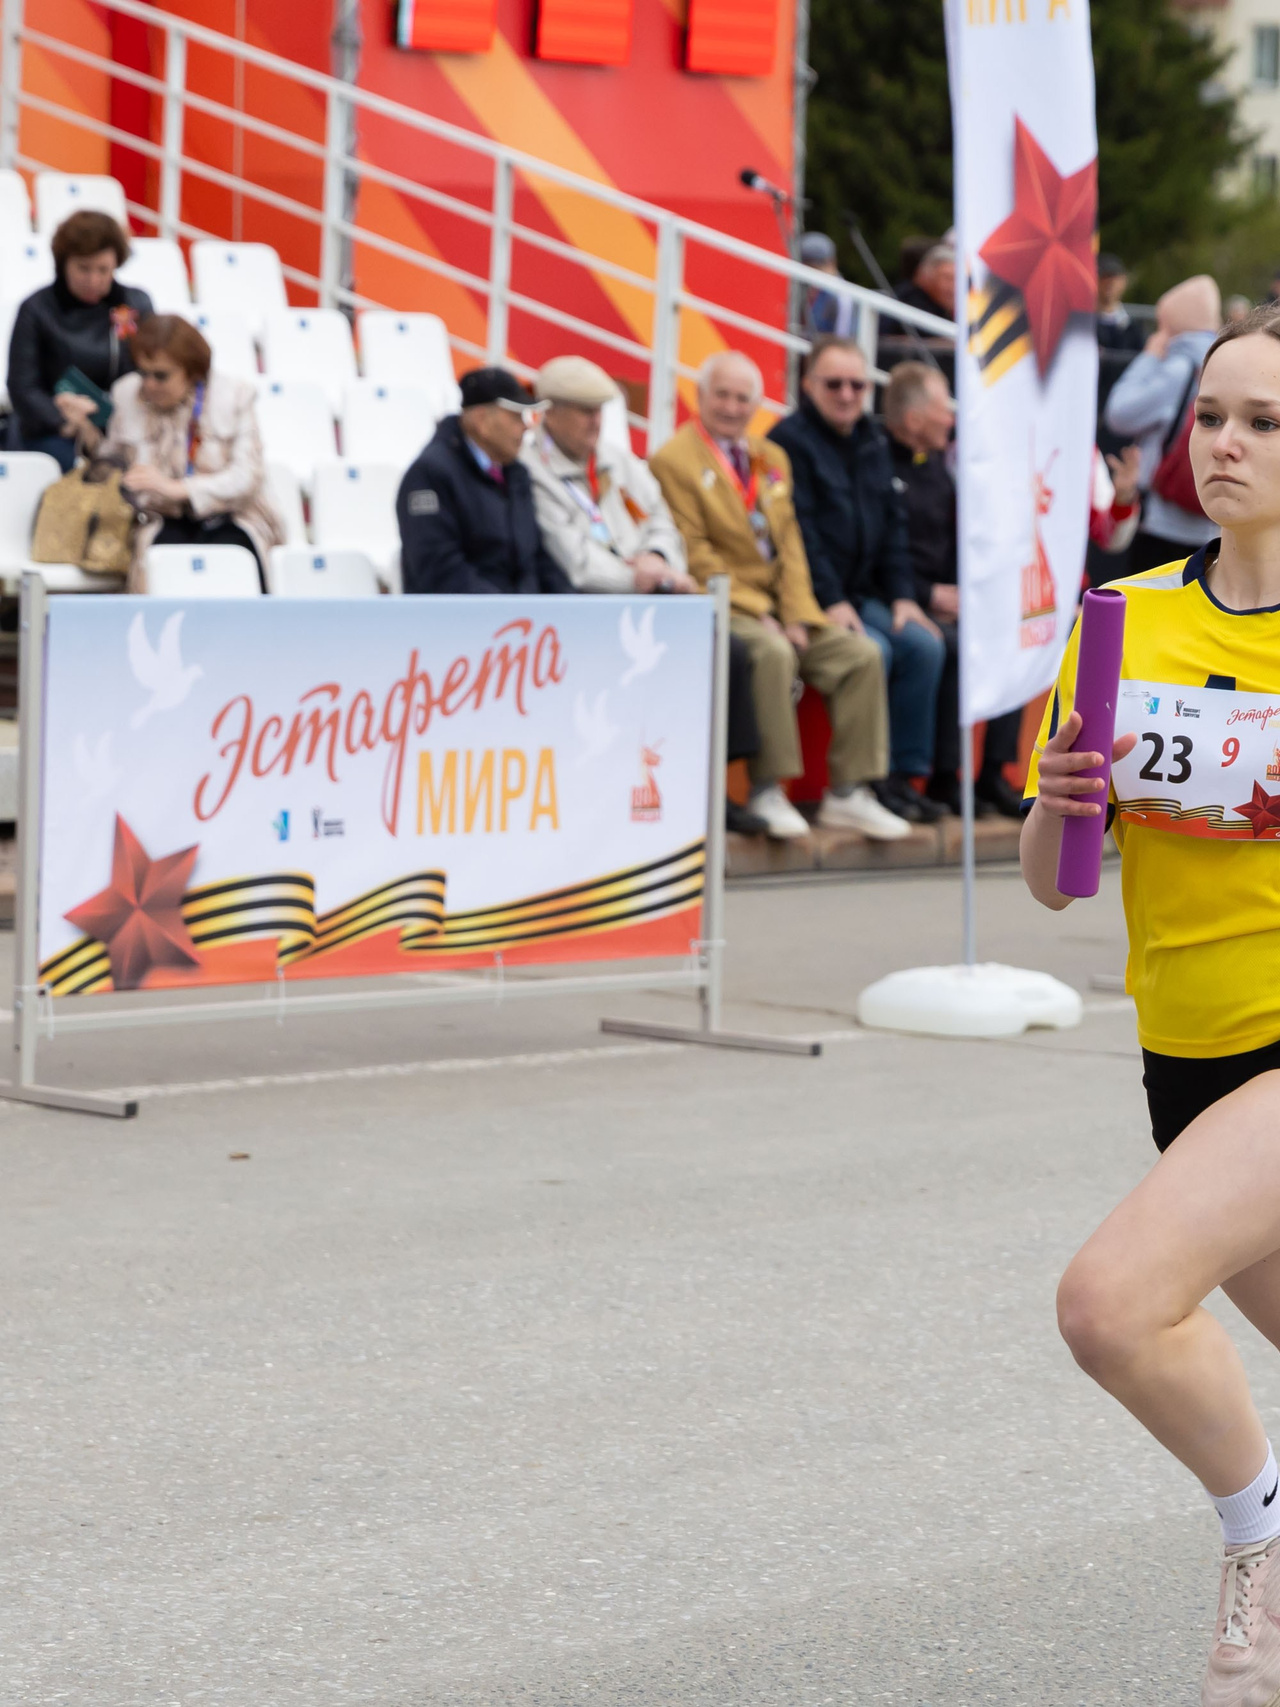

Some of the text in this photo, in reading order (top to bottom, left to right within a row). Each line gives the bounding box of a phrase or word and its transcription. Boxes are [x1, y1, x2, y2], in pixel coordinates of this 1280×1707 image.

[194, 618, 567, 837] Эстафета
[1139, 732, 1193, 784] 23
[1221, 737, 1240, 768] 9
[415, 747, 560, 836] МИРА
